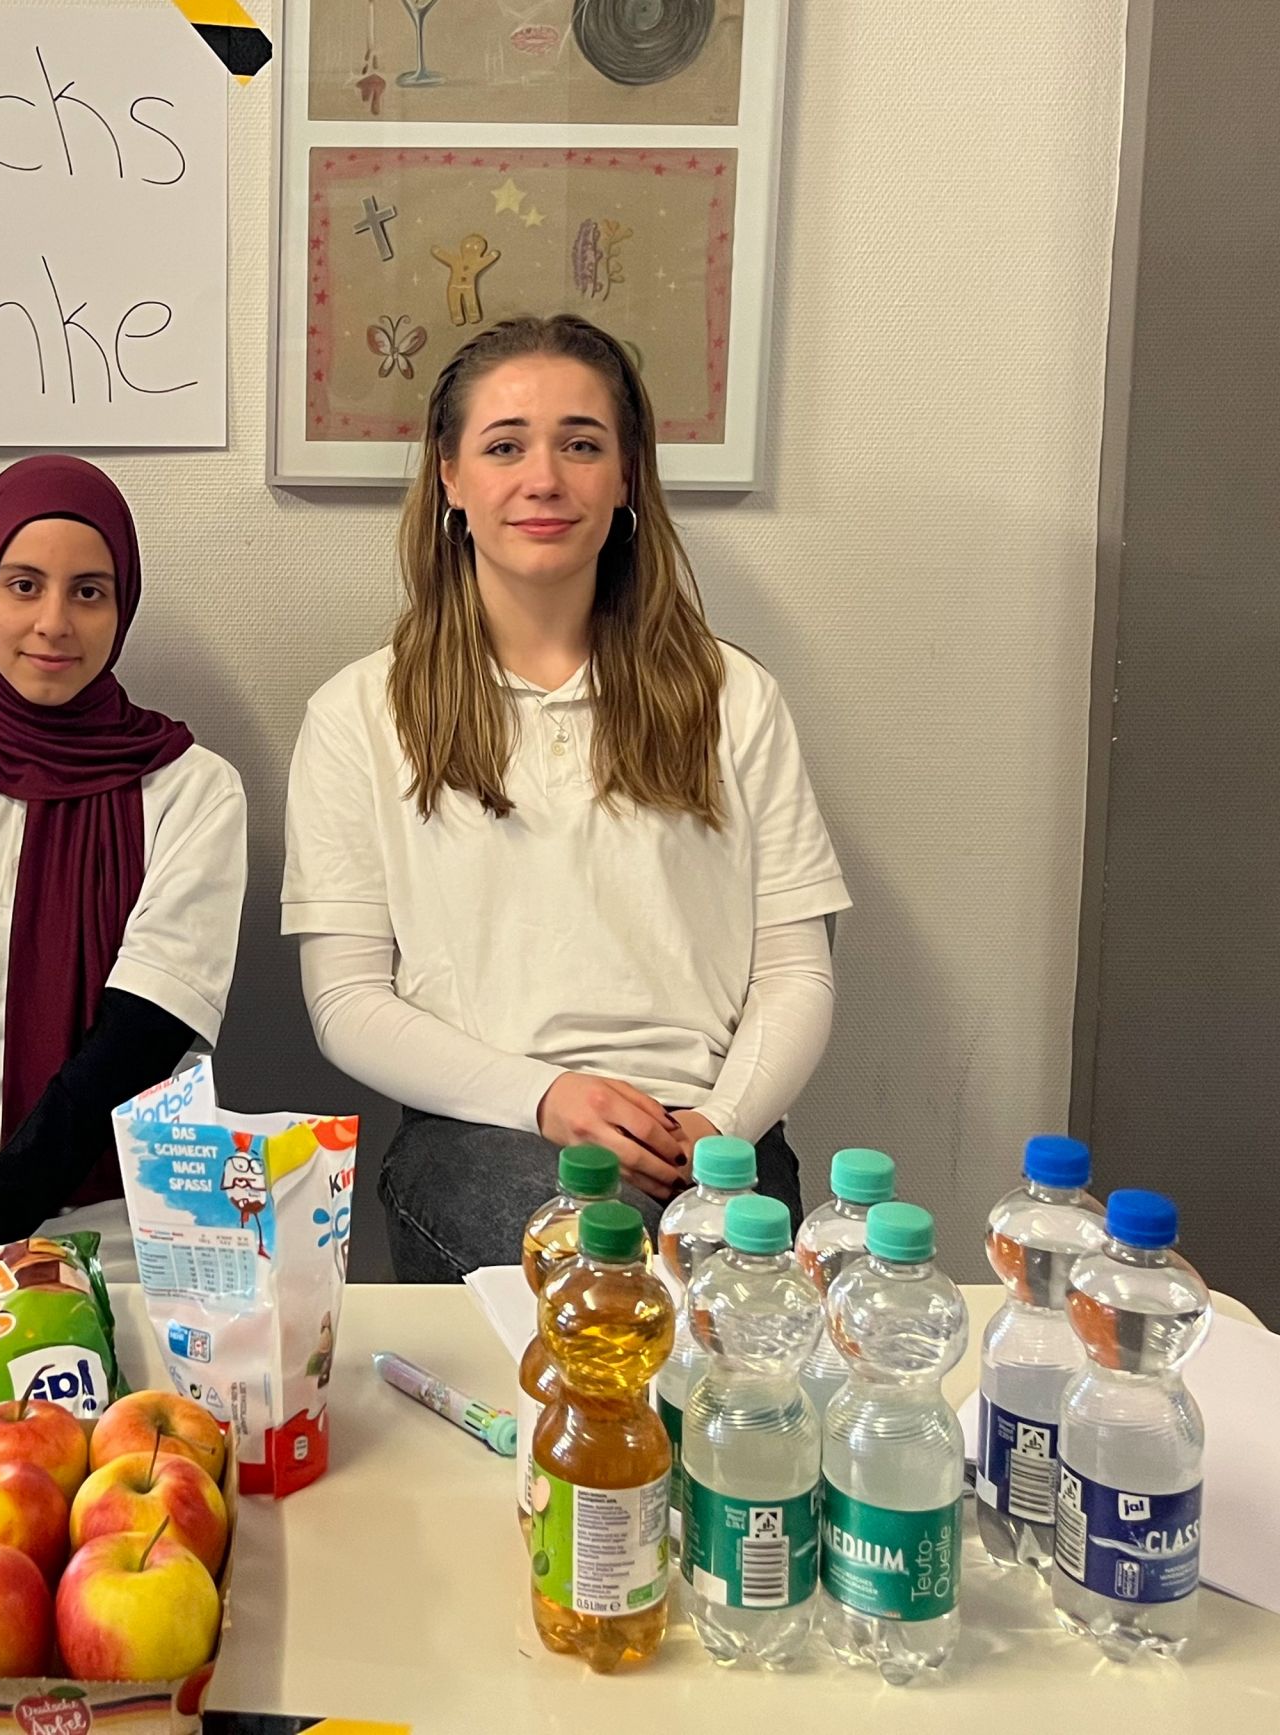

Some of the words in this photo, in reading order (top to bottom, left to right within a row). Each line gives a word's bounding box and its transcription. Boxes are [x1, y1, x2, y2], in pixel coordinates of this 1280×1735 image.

[172, 1126, 197, 1140] DAS
[154, 1142, 219, 1159] SCHMECKT
[172, 1161, 206, 1175] NACH
[168, 1177, 213, 1192] SPASS!
[822, 1516, 906, 1572] MEDIUM
[911, 1530, 933, 1602] Teuto-
[934, 1525, 952, 1598] Quelle
[21, 1698, 79, 1718] Deutsche
